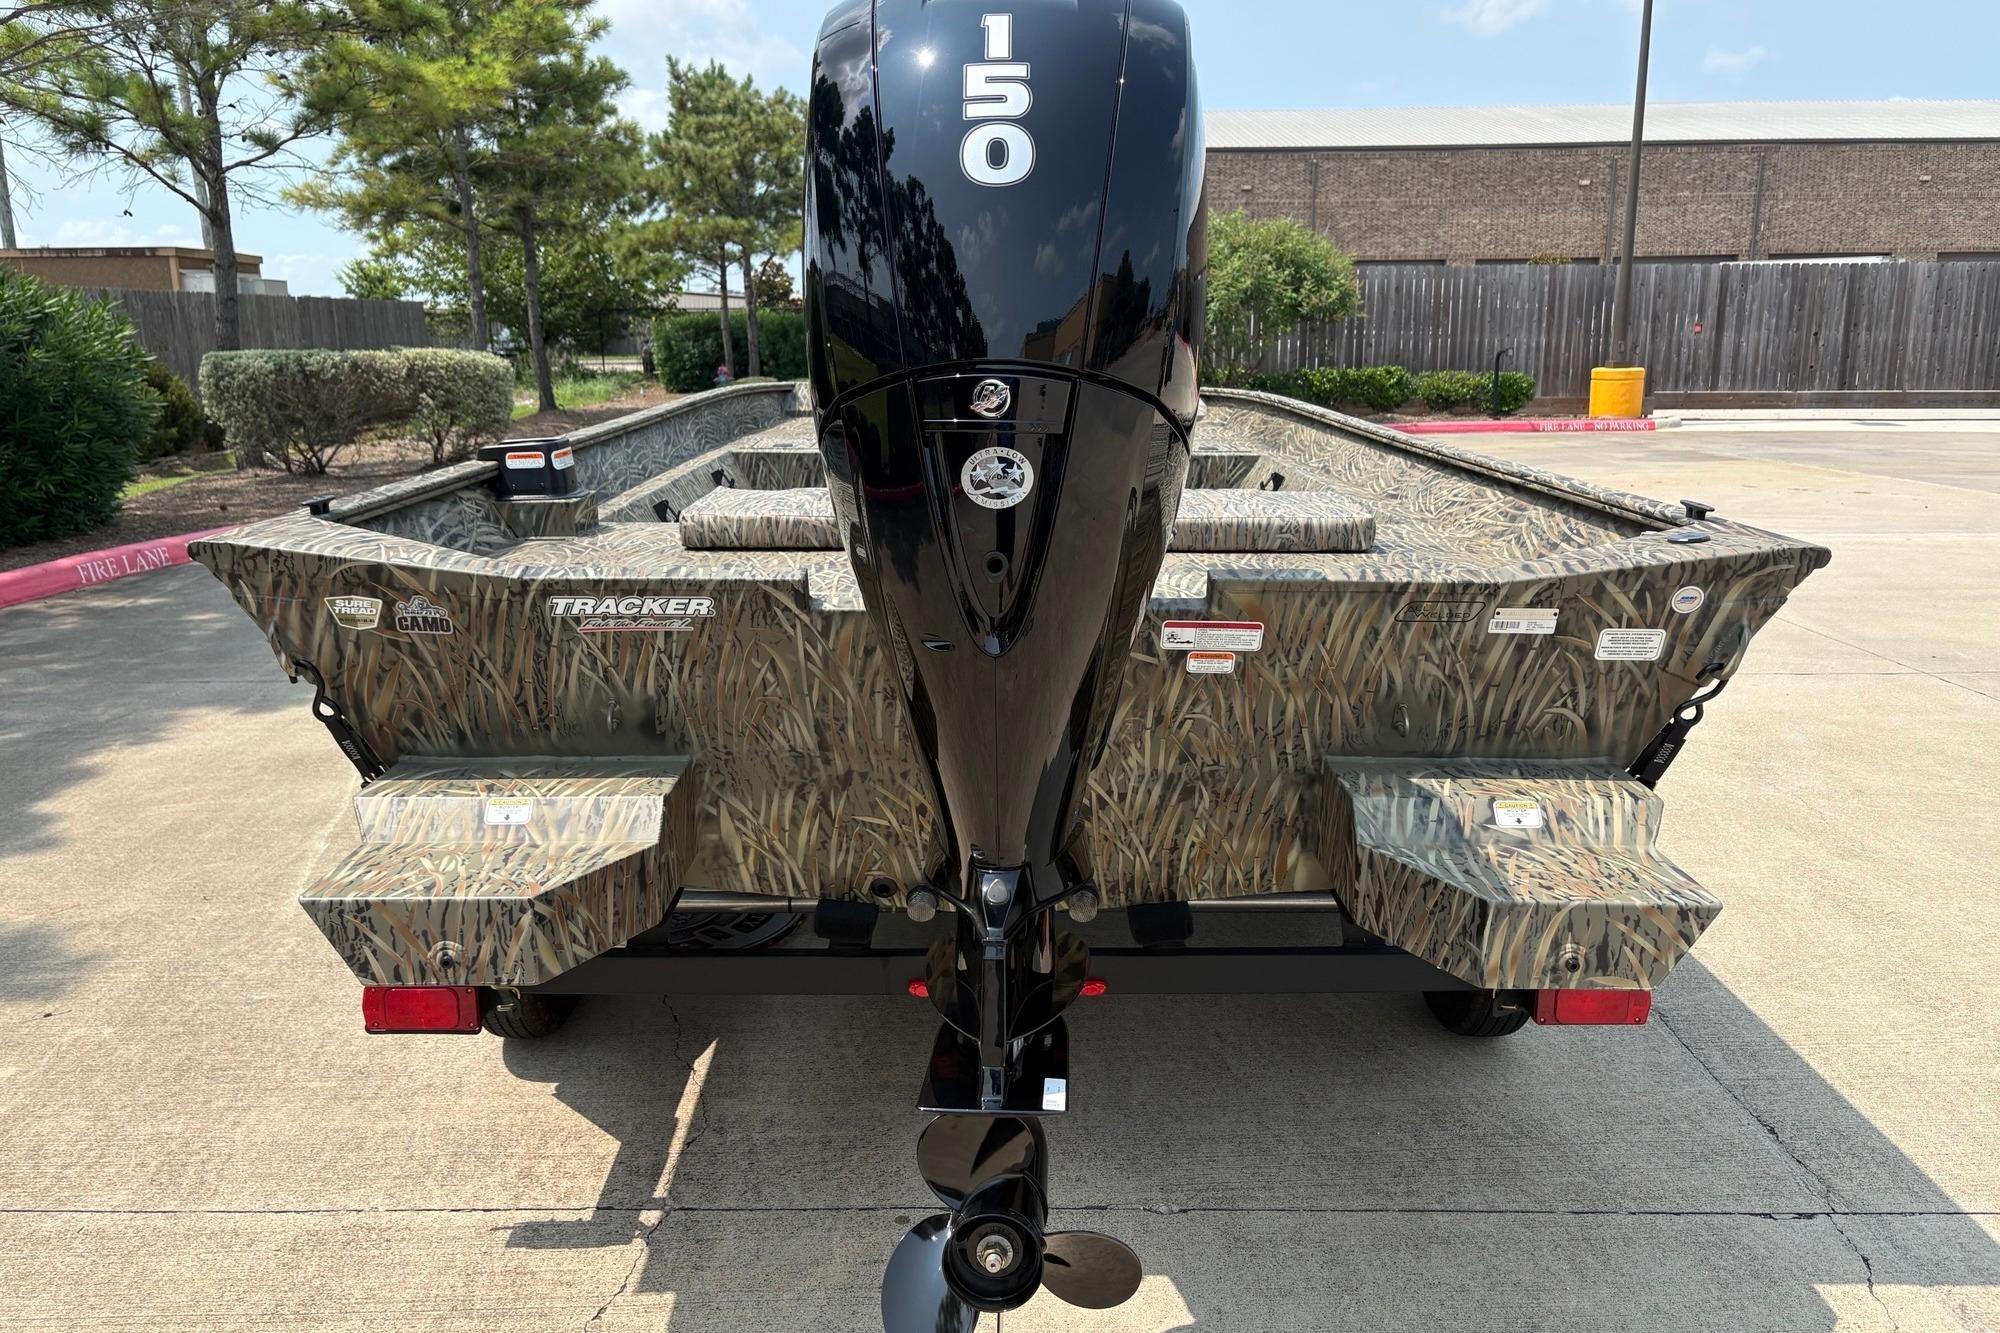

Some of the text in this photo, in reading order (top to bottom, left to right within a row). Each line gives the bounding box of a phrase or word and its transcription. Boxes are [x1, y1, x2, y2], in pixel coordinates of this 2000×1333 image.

[959, 13, 1036, 187] 150
[1540, 421, 1649, 431] FIRE LANE NO PARKING
[76, 547, 173, 584] FIRE LANE
[335, 599, 373, 608] SURE
[550, 596, 715, 616] TRACKER
[1404, 601, 1431, 614] ALL
[333, 606, 377, 615] TREAD
[1411, 609, 1471, 619] WELDED
[397, 616, 452, 632] CAMO
